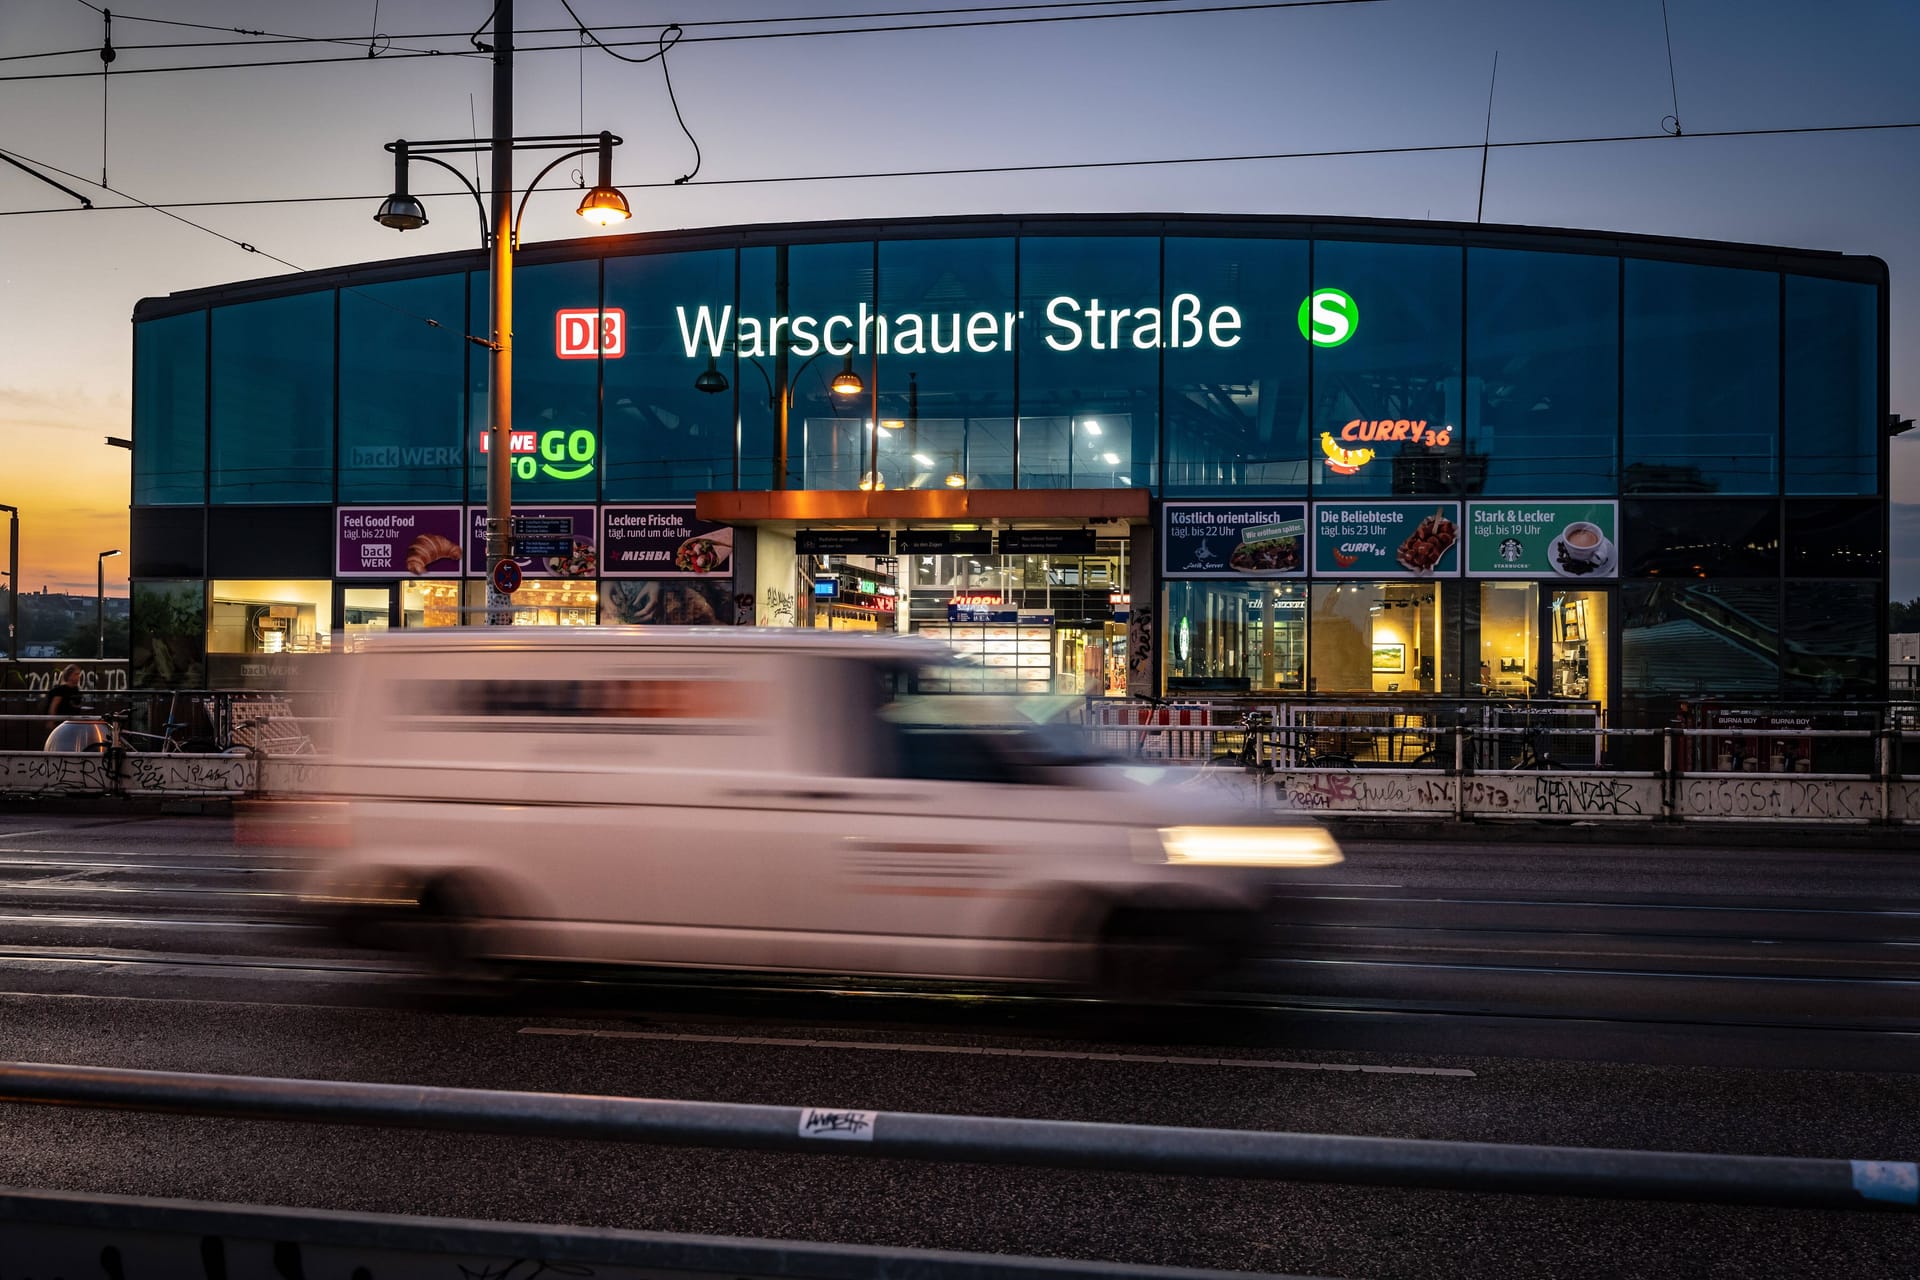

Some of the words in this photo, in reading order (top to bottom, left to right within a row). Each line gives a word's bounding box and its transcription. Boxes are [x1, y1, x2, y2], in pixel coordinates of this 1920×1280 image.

[1305, 290, 1354, 345] S
[676, 302, 1025, 358] Warschauer
[1045, 293, 1242, 352] Straße
[563, 313, 621, 354] DB
[1341, 419, 1427, 443] CURRY
[1425, 430, 1450, 447] 36
[483, 434, 534, 451] WE
[541, 429, 596, 462] GO
[344, 515, 363, 527] Feel
[365, 515, 389, 527] Good
[391, 515, 415, 527] Food
[608, 514, 646, 526] Leckere
[648, 514, 683, 526] Frische
[1171, 512, 1214, 524] Köstlich
[1217, 512, 1280, 524] orientalisch
[1321, 511, 1339, 523] Die
[1341, 511, 1403, 523] Beliebteste
[1475, 510, 1505, 522] Stark
[1507, 510, 1516, 522] &
[1518, 510, 1555, 522] Lecker
[344, 529, 360, 540] tägl.
[362, 529, 373, 538] bis
[374, 529, 384, 538] 22
[385, 529, 400, 538] Uhr
[608, 528, 625, 540] tägl.
[627, 528, 646, 538] rund
[648, 530, 660, 538] um
[662, 528, 675, 538] die
[676, 528, 692, 538] Uhr
[1171, 527, 1189, 538] tägl.
[1191, 527, 1204, 536] bis
[1205, 527, 1218, 536] 22
[1220, 527, 1235, 536] Uhr
[1321, 526, 1340, 537] tägl.
[1342, 526, 1355, 535] bis
[1356, 526, 1368, 535] 23
[1371, 526, 1387, 535] Uhr
[1475, 525, 1494, 537] tägl.
[1496, 525, 1509, 535] bis
[1511, 525, 1521, 535] 19
[1524, 525, 1541, 535] Uhr
[362, 544, 391, 557] back
[1340, 543, 1376, 553] CURRY
[621, 551, 671, 561] MISHBA
[361, 559, 392, 568] WERK
